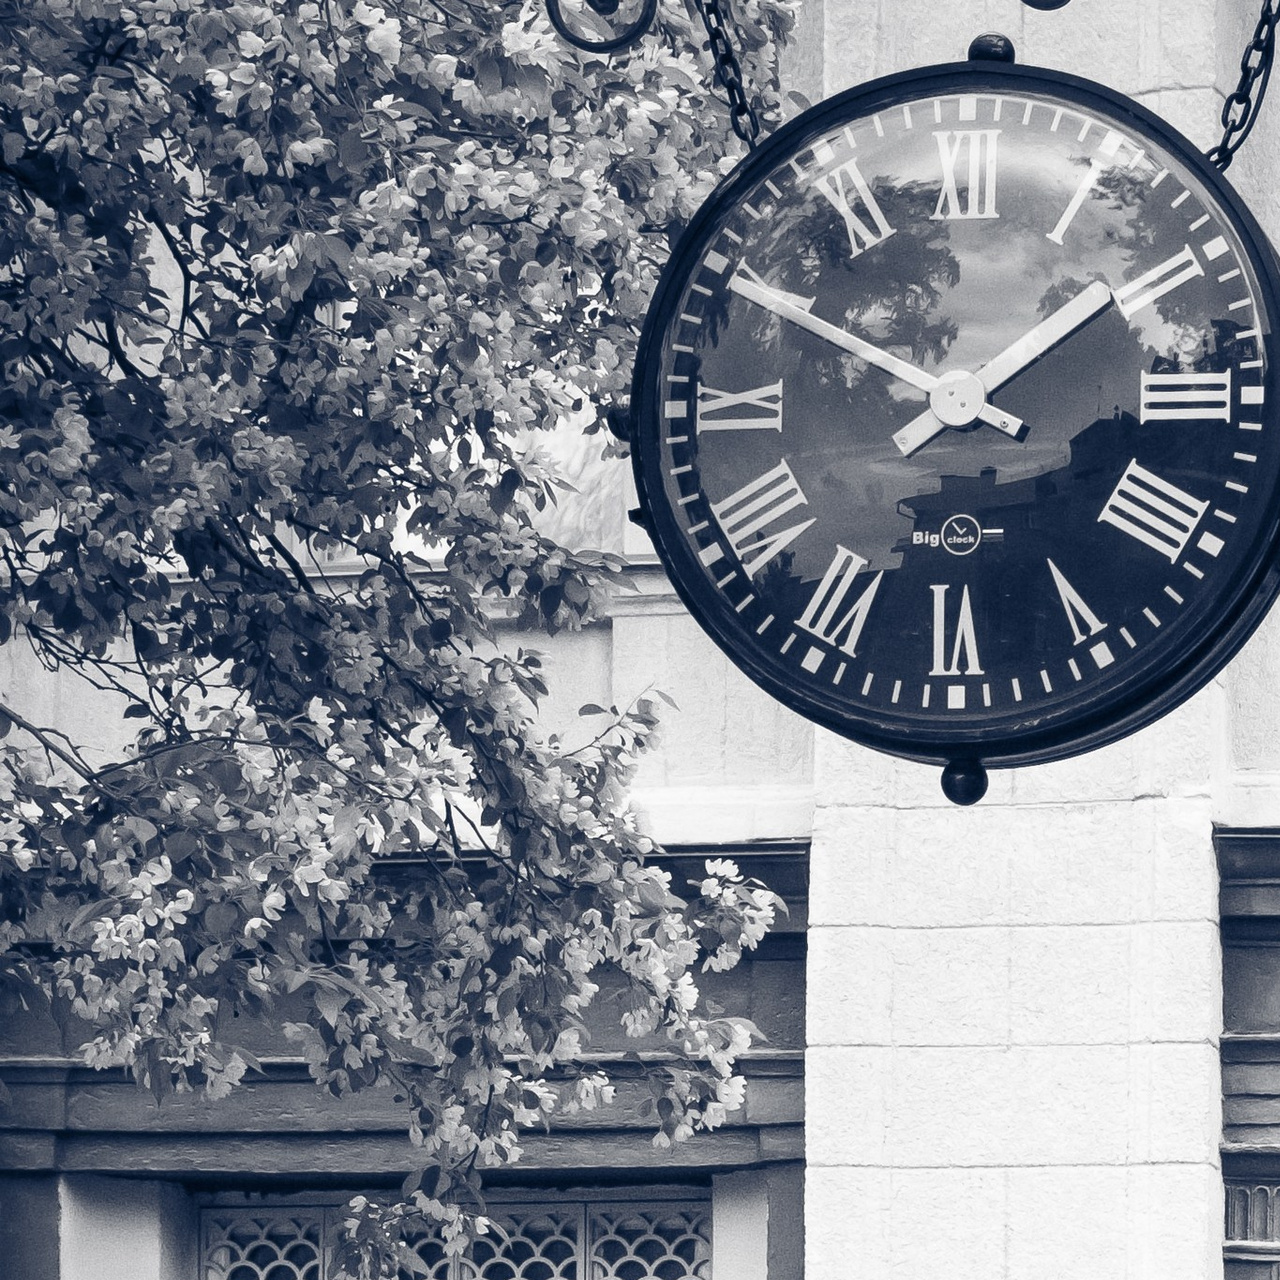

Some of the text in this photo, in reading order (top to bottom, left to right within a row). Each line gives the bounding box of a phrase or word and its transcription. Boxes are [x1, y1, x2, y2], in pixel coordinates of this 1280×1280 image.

[813, 157, 898, 260] XI
[929, 129, 1002, 220] XII
[1046, 157, 1101, 246] I
[1110, 243, 1205, 321] II
[697, 379, 783, 434] IX
[1140, 369, 1232, 424] III
[710, 458, 817, 579] VIII
[912, 531, 975, 547] Big clock
[1098, 458, 1210, 563] IIII
[794, 545, 885, 658] VII
[929, 584, 985, 676] VI
[1047, 558, 1108, 646] V
